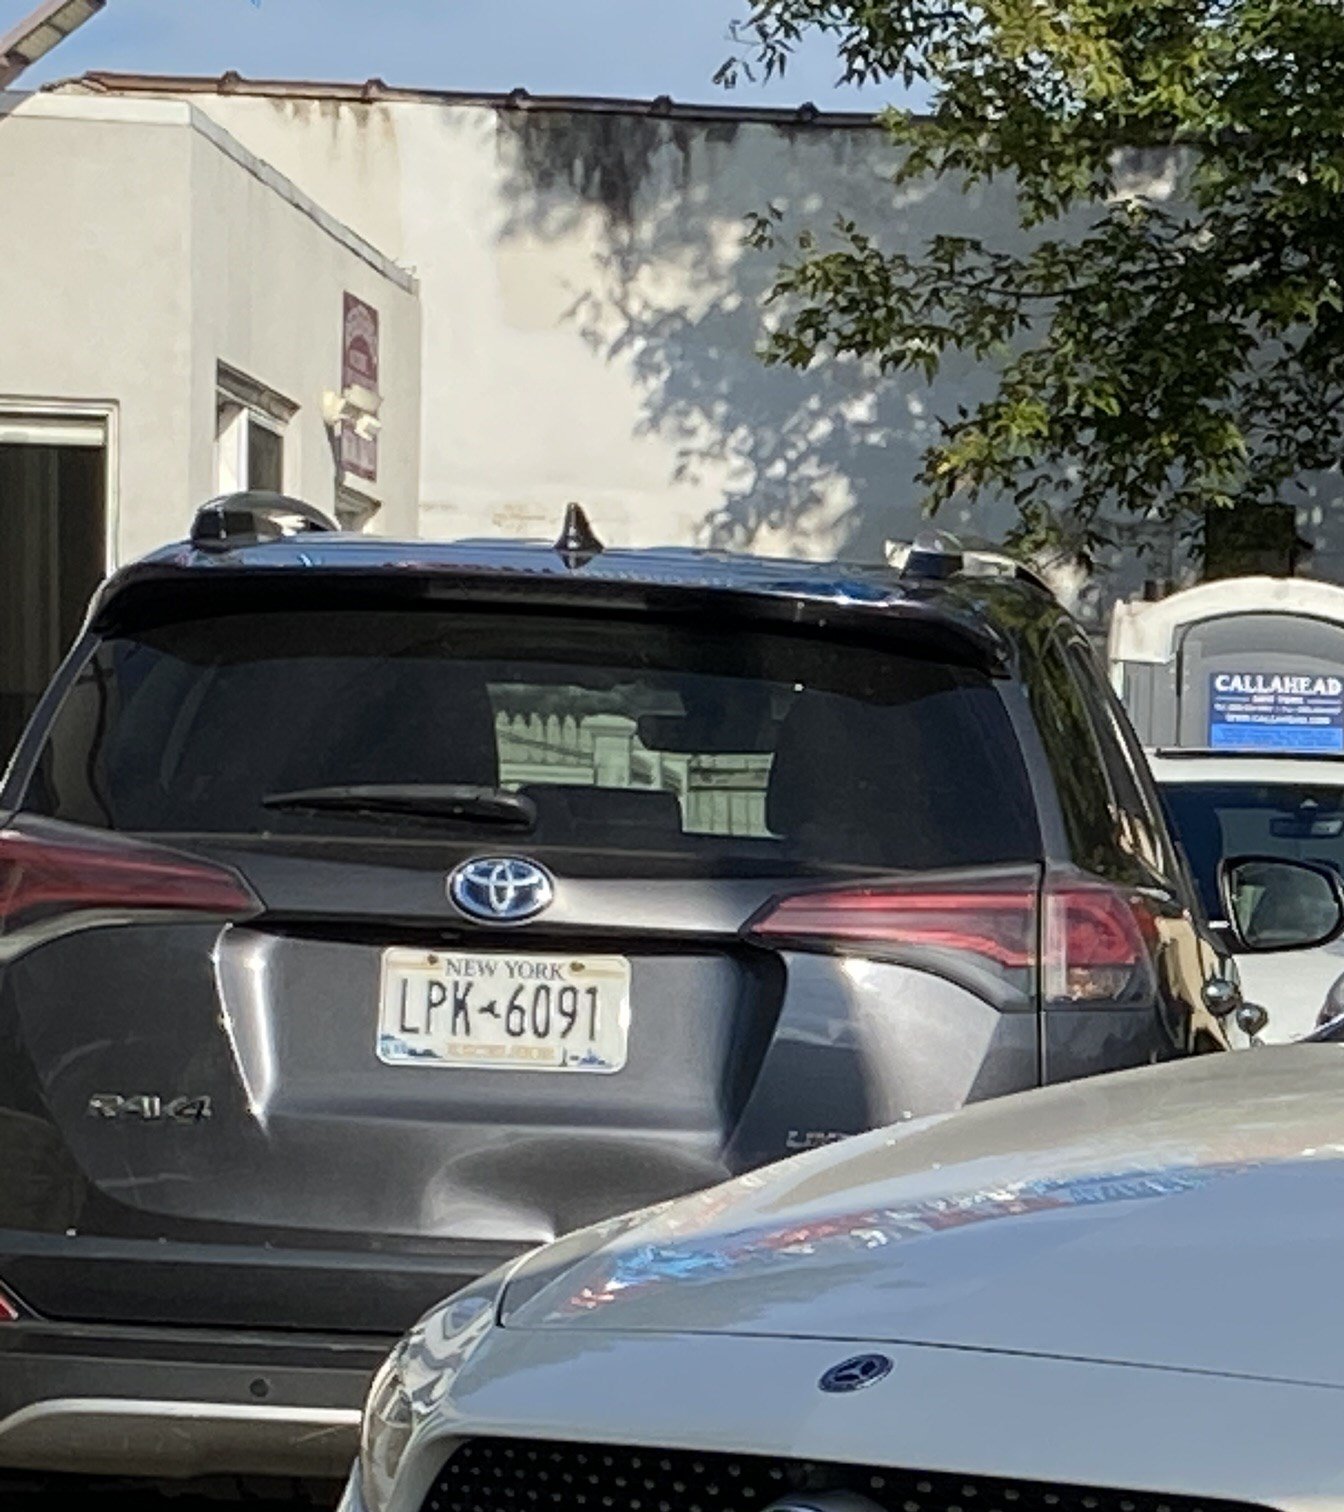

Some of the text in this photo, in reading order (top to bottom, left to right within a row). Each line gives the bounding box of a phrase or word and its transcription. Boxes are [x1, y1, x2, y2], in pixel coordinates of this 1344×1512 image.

[1214, 674, 1343, 696] CALLAHEAD
[445, 957, 564, 982] NEW YORK
